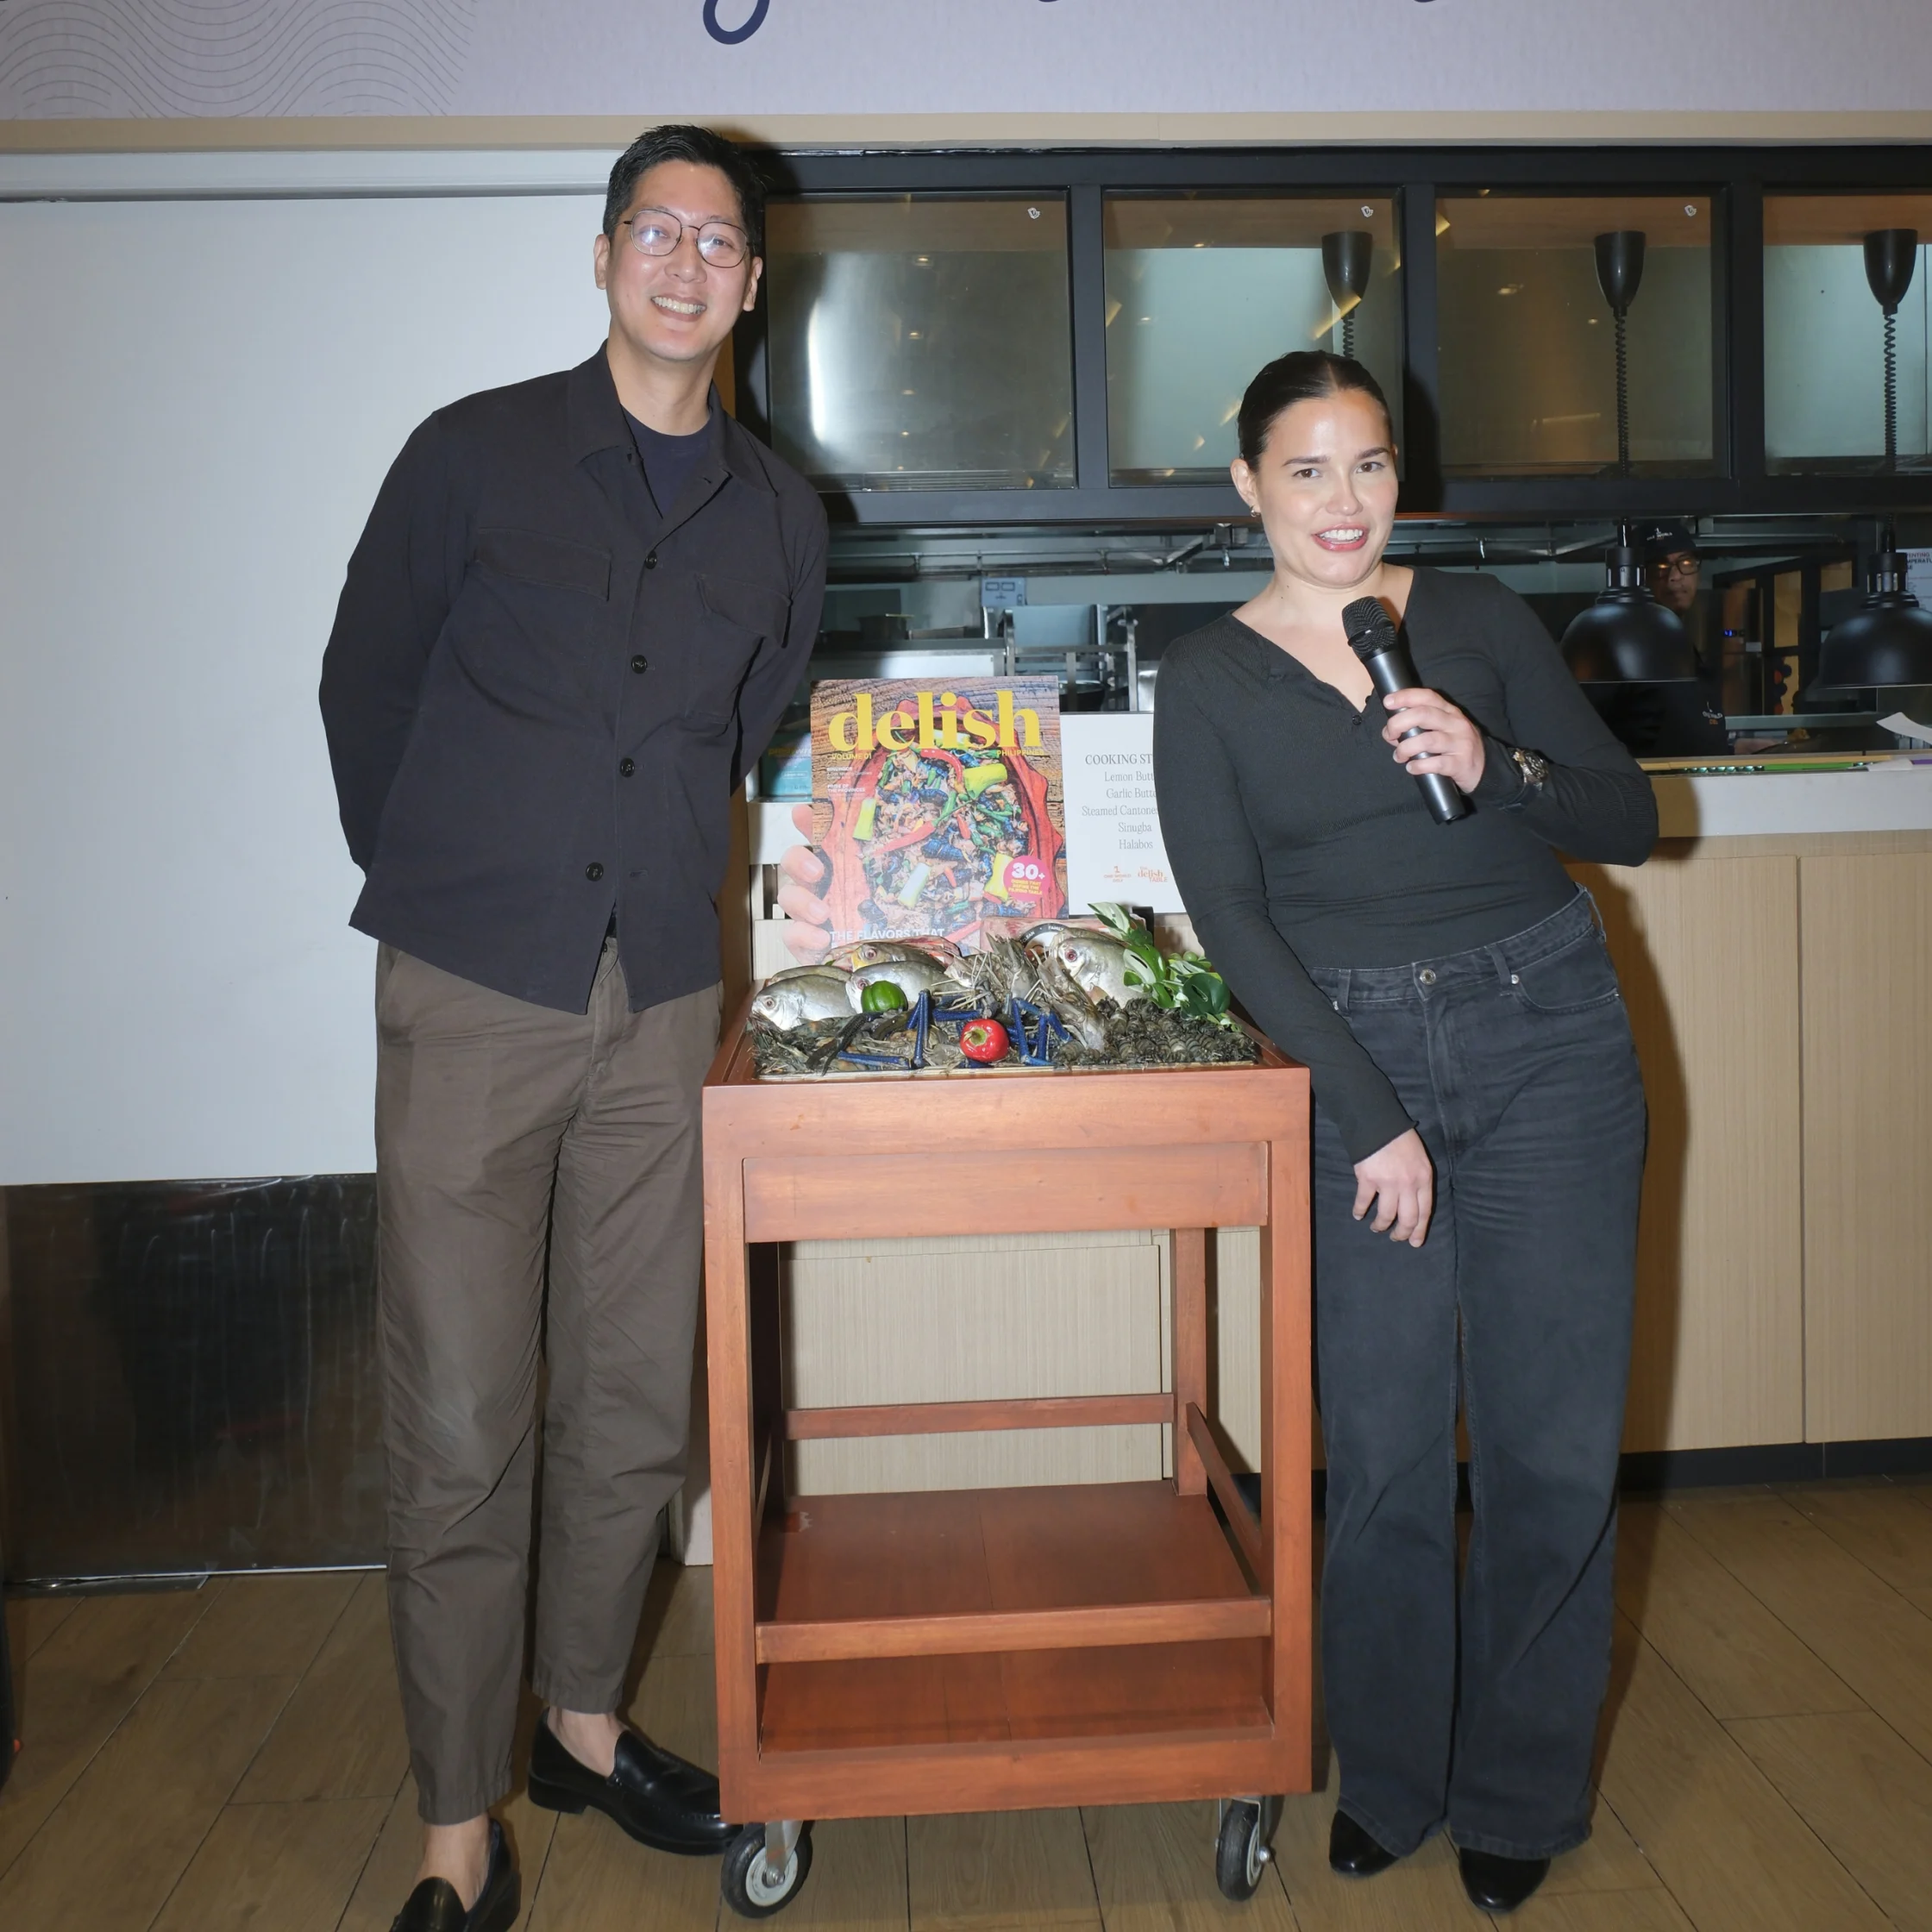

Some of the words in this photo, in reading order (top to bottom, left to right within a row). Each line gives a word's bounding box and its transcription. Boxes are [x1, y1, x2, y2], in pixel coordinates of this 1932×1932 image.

[828, 690, 1042, 750] delish
[1085, 754, 1137, 765] COOKING
[1139, 753, 1153, 764] ST
[1104, 771, 1133, 781] Lemon
[1136, 770, 1154, 781] Butt
[1106, 787, 1132, 799] Garlic
[1134, 787, 1157, 799] Butte
[1082, 806, 1118, 817] Steamed
[1118, 822, 1152, 834] Sinugba
[1119, 839, 1153, 850] Halabos
[1011, 862, 1045, 880] 30+
[1137, 869, 1163, 878] delish
[830, 931, 853, 941] THE
[856, 929, 911, 939] FLAVORS
[913, 928, 945, 938] THAT
